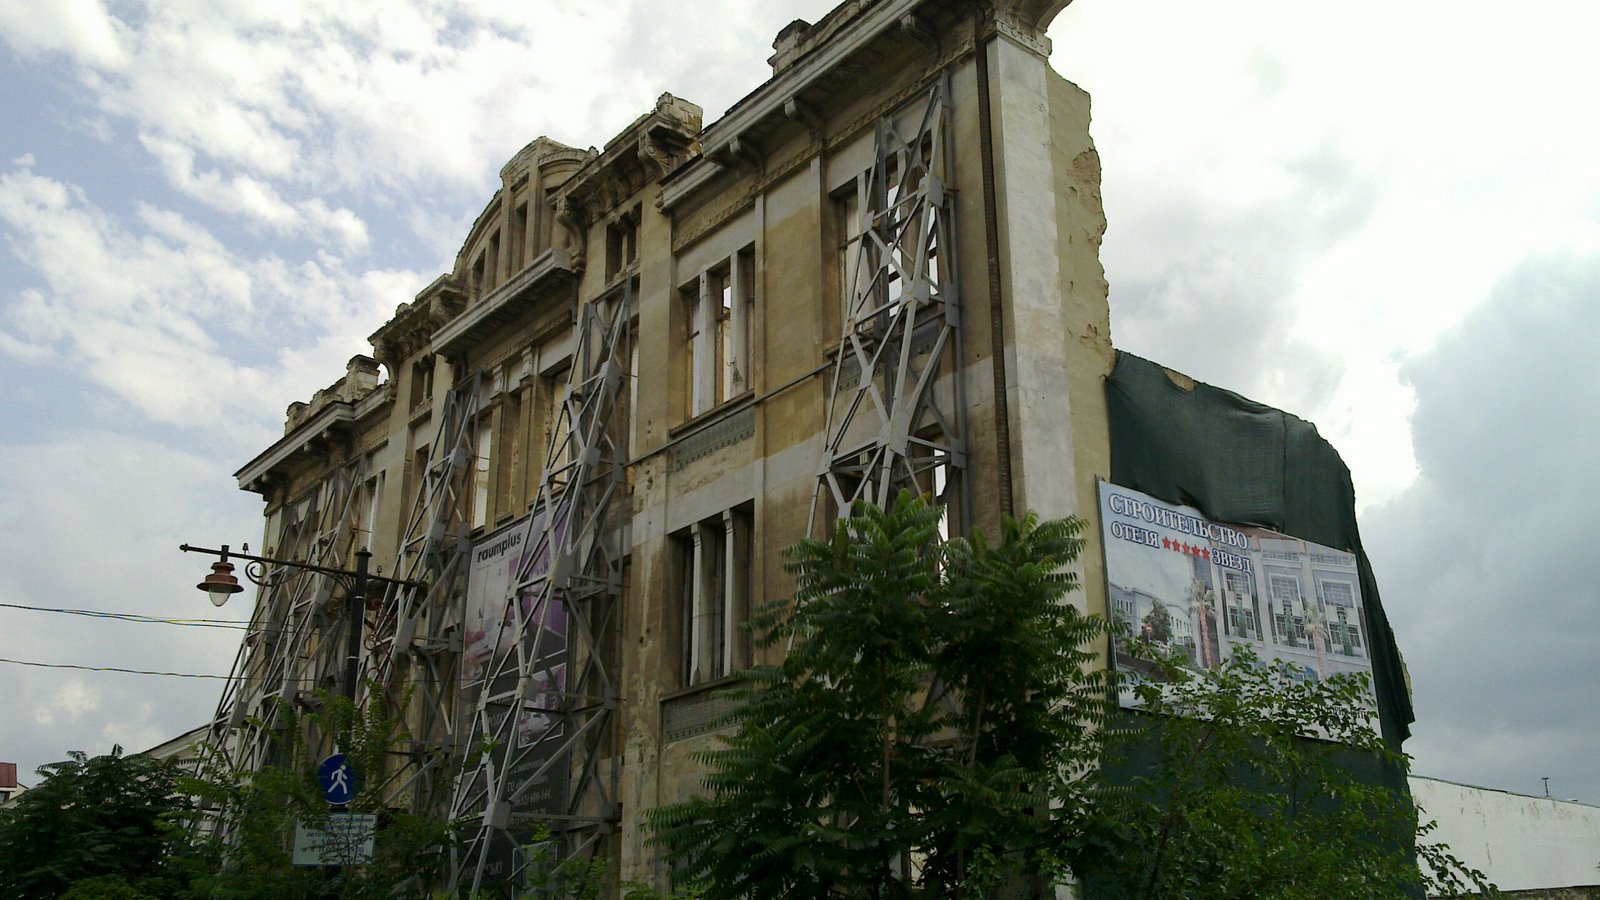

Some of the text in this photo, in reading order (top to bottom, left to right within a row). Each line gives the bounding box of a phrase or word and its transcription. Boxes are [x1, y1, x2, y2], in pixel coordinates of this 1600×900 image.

[477, 532, 521, 563] raumplus
[1109, 493, 1249, 550] СТРОИТЕЛЬСТВО
[1111, 521, 1253, 575] ОТЕЛЯ ЗВЕЗД
